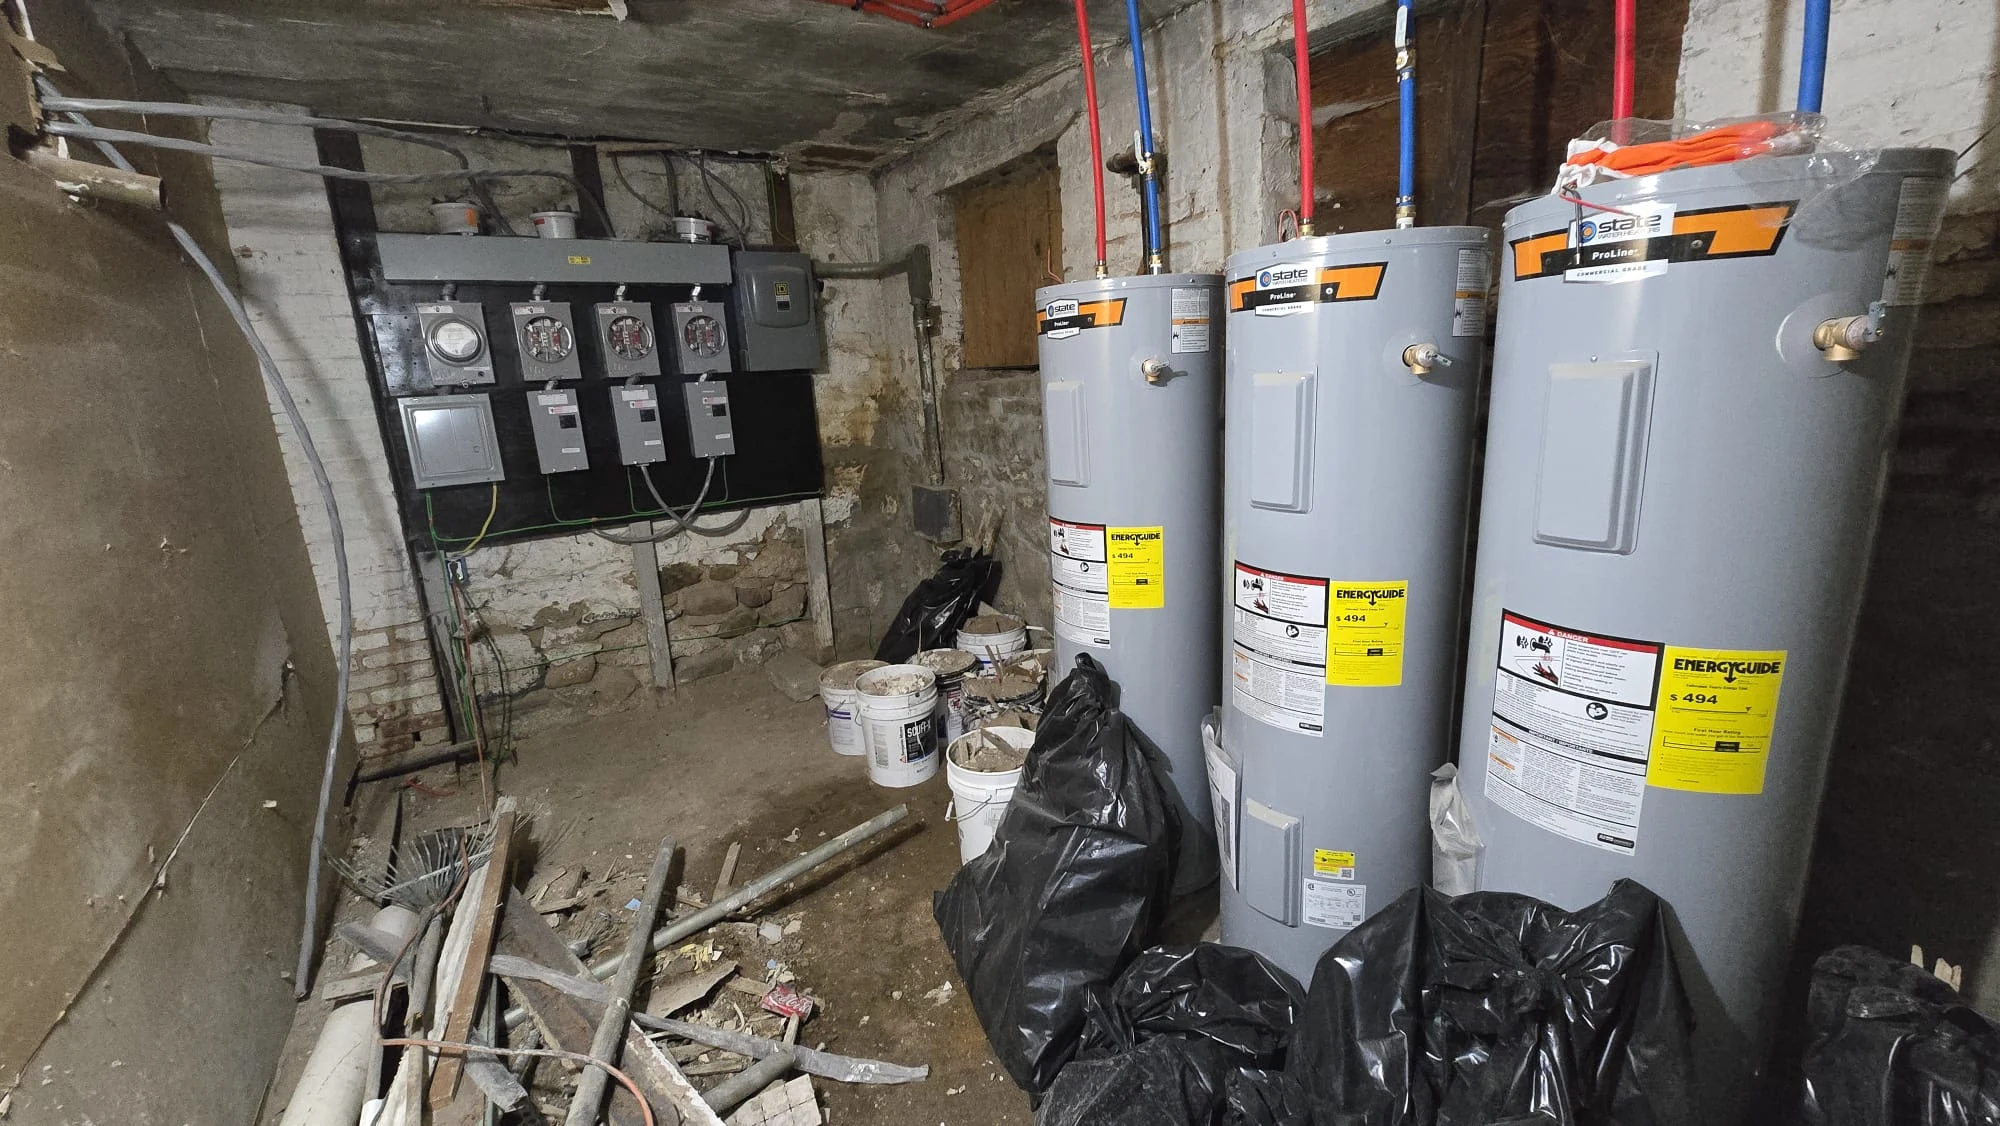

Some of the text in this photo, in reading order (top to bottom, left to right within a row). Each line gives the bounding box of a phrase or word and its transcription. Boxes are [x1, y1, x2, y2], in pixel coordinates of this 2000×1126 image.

[1598, 214, 1662, 234] state
[1623, 227, 1661, 237] HEATRS
[1272, 269, 1308, 281] state
[1577, 267, 1620, 277] COMMERCIAL
[1055, 304, 1076, 313] state
[1111, 532, 1161, 542] ENERGYGUIDE
[1336, 588, 1405, 601] ENERGYGUIDE
[1343, 614, 1366, 622] 494
[1557, 631, 1589, 643] DANGER
[1674, 657, 1782, 677] ENERGYGUIDE
[1682, 693, 1718, 705] 494
